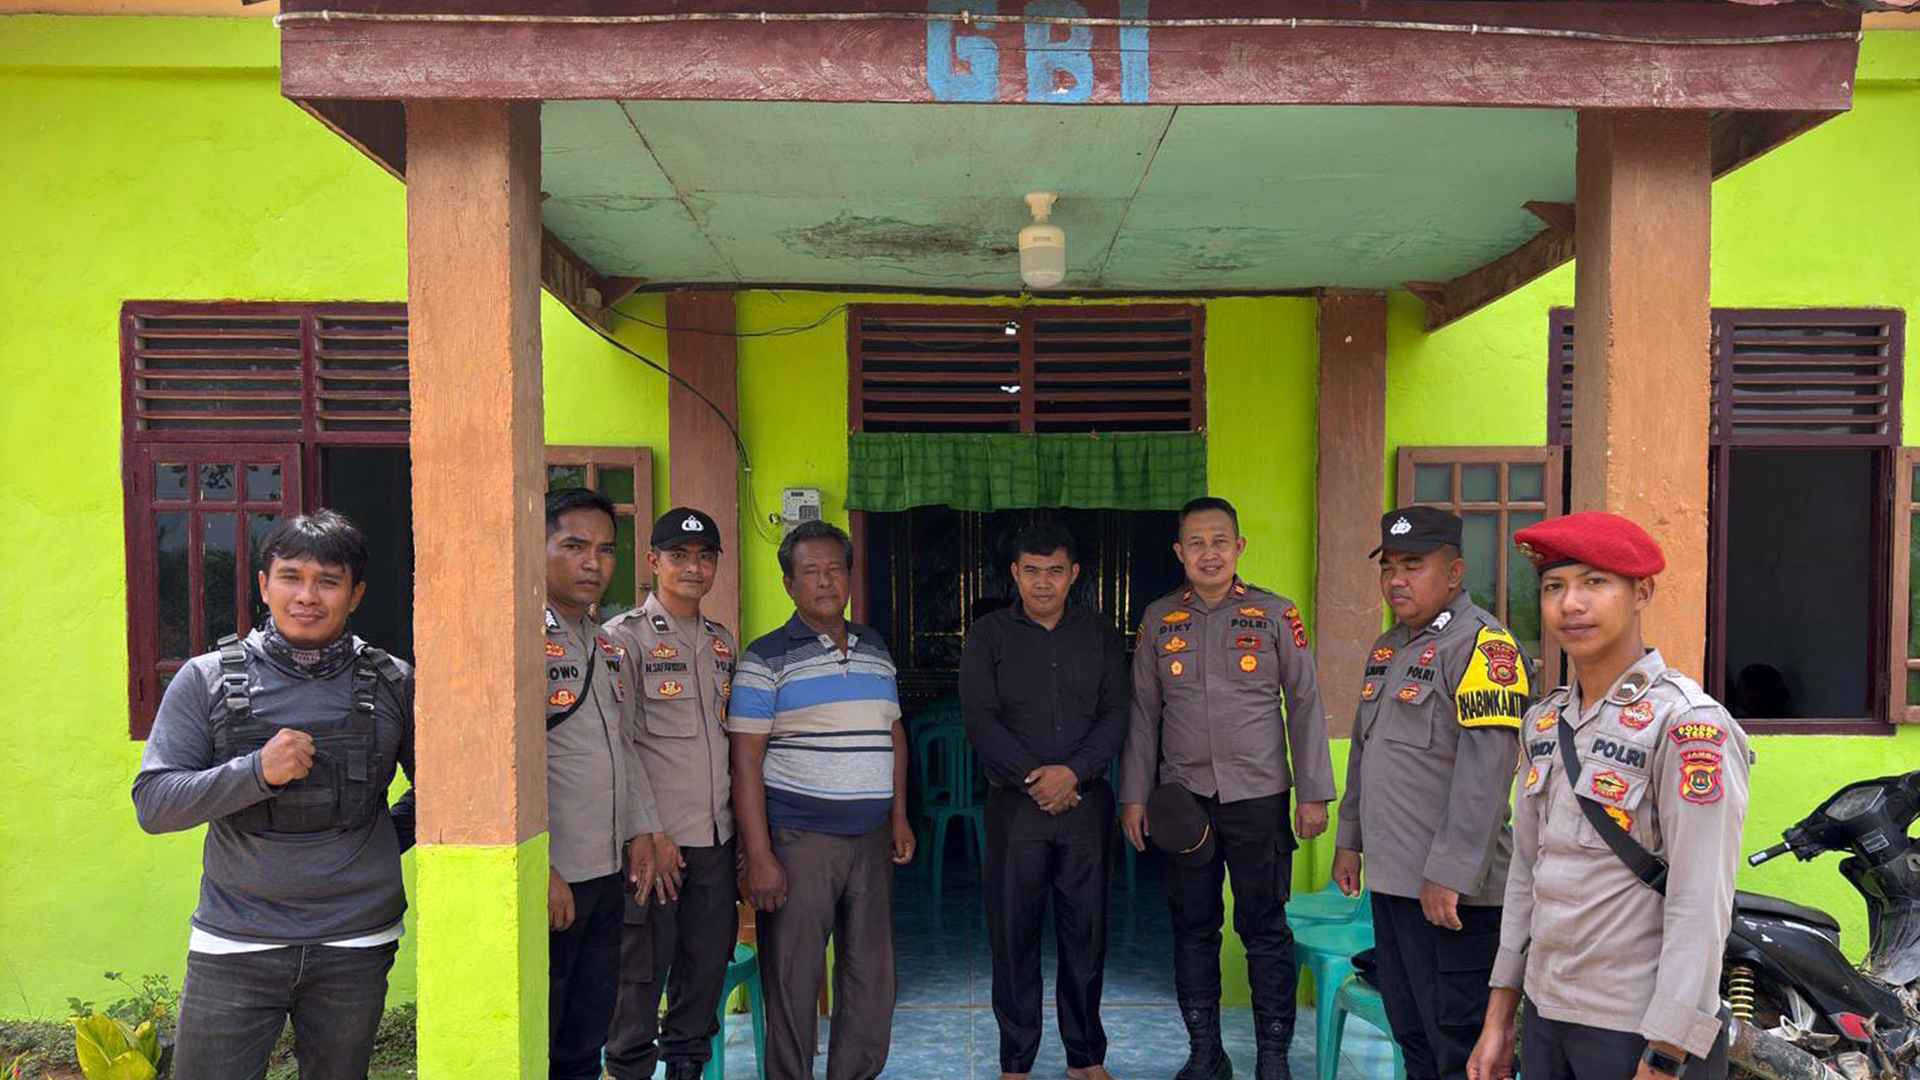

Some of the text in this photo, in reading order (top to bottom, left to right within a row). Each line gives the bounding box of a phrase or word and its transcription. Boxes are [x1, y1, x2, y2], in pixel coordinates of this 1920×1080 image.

[927, 0, 1149, 103] GBI
[1160, 623, 1192, 635] DIKY
[1231, 618, 1267, 629] POLRI
[549, 665, 579, 681] OWO
[1406, 665, 1436, 682] POLRI
[1592, 738, 1647, 769] POLRI
